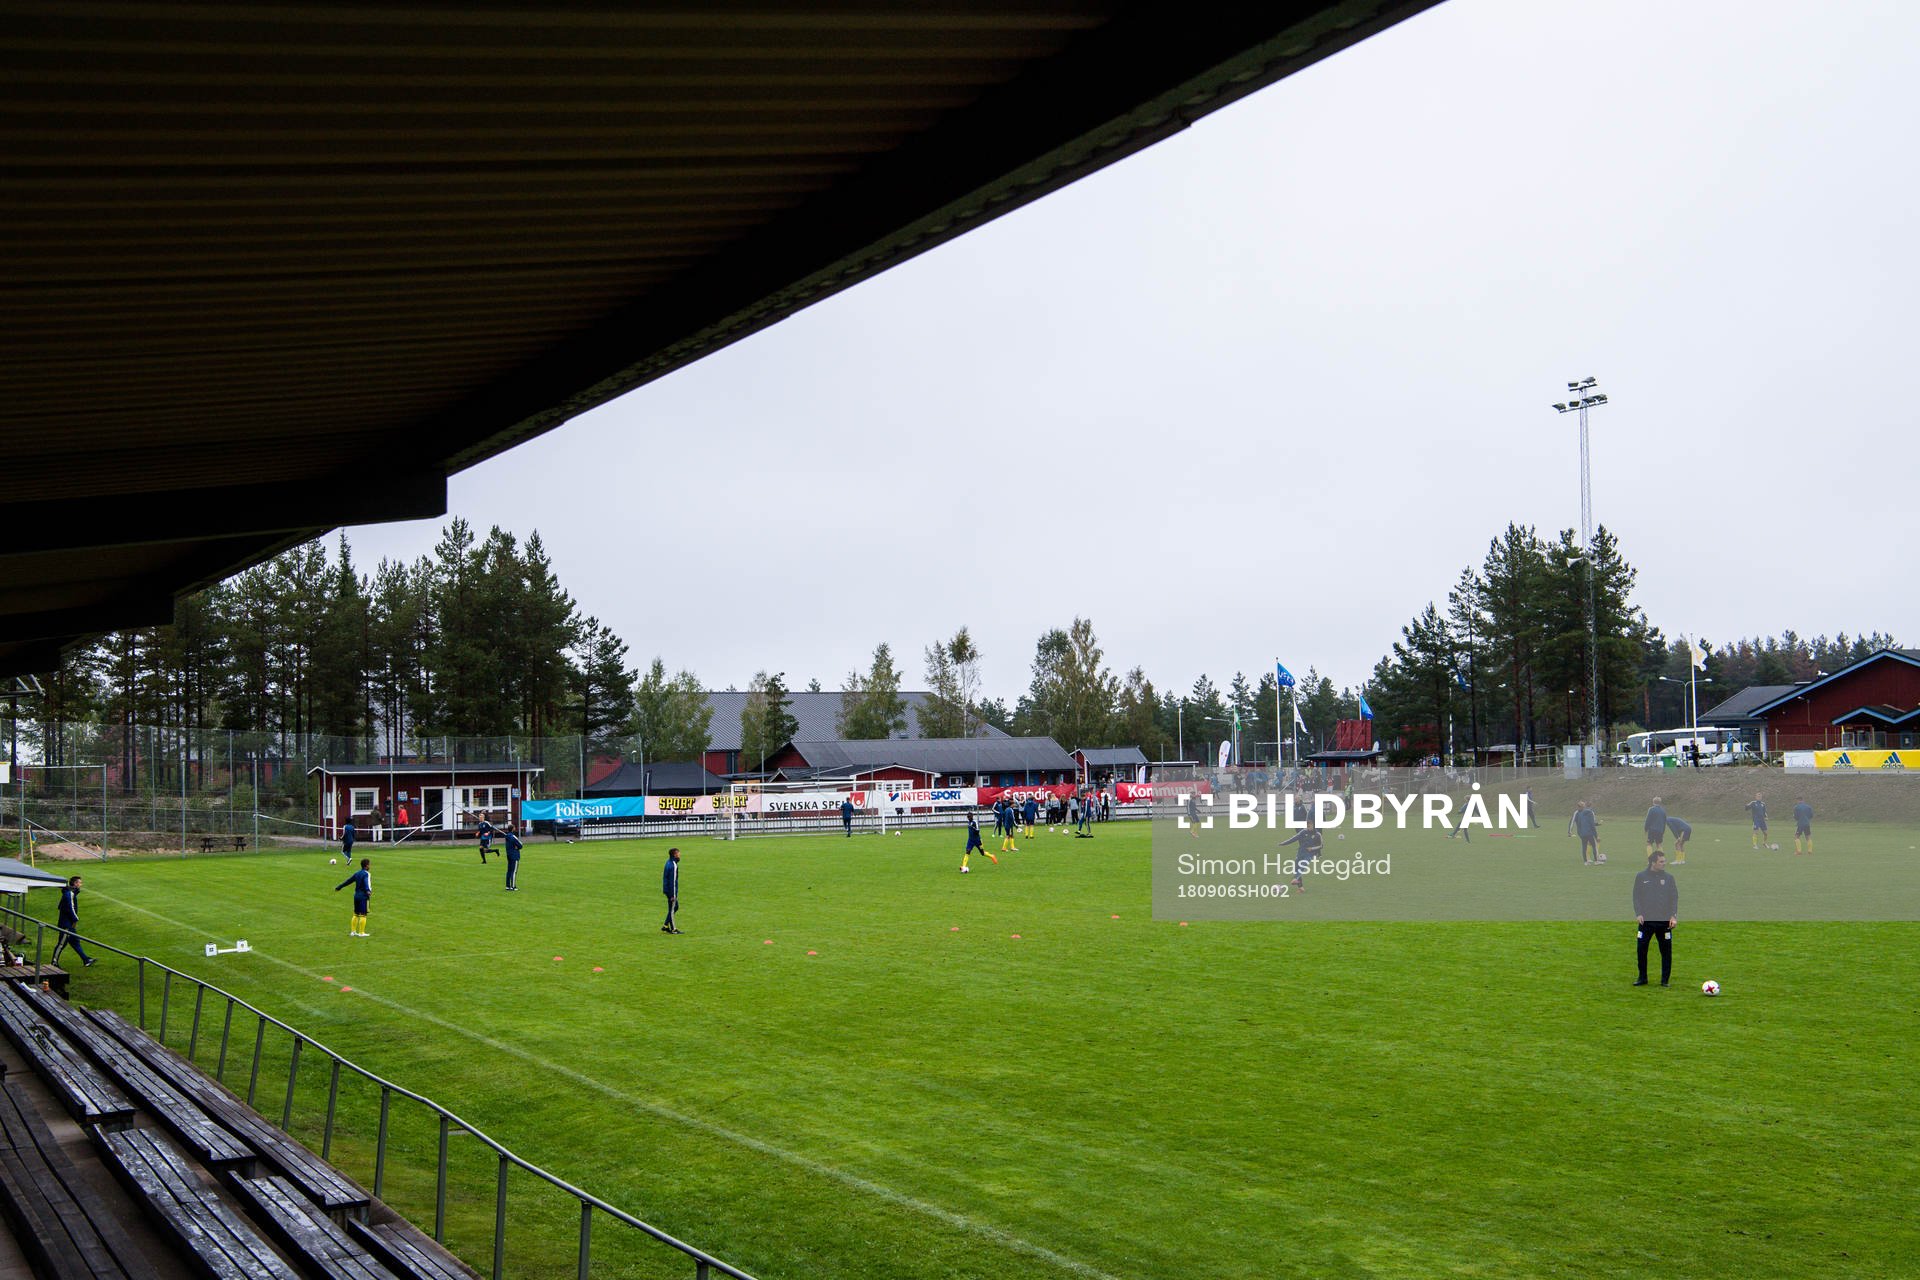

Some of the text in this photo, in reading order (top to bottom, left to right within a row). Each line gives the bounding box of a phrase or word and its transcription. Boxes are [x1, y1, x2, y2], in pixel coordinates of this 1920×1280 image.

[712, 795, 749, 809] SPORT
[900, 790, 962, 802] INTERSPORT
[555, 801, 613, 817] Folksam
[658, 797, 696, 810] SPORT
[769, 800, 819, 811] SVENSKA
